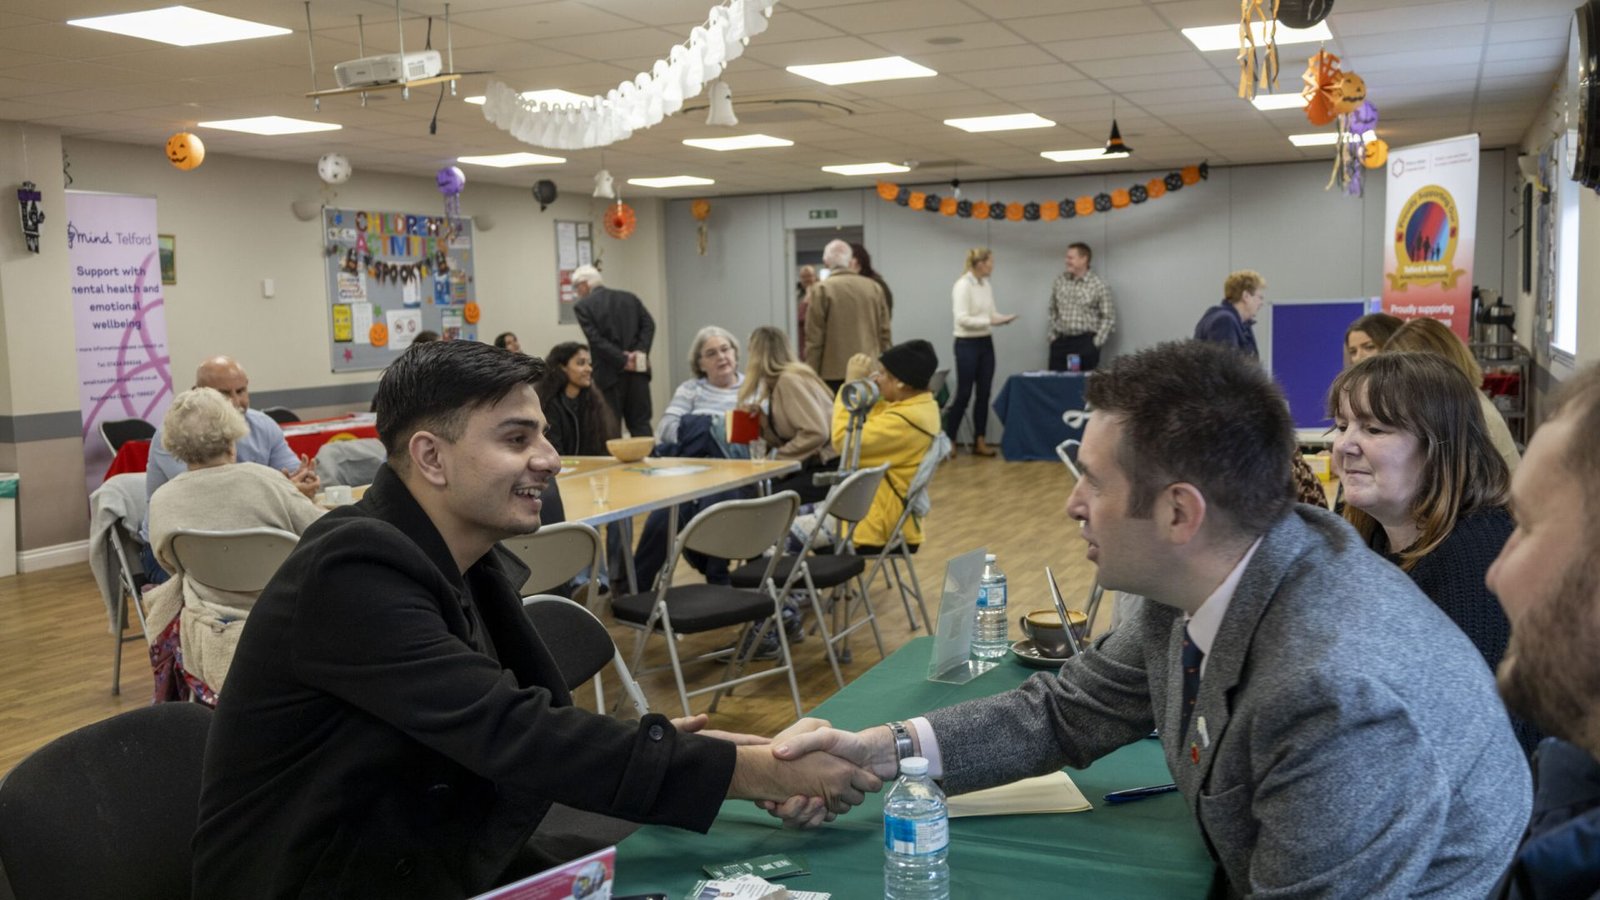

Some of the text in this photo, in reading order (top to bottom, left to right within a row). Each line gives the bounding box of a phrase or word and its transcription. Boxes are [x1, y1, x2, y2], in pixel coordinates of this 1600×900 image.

[77, 231, 152, 245] mind Telford
[76, 265, 146, 278] Support with
[106, 283, 140, 294] health
[143, 284, 159, 293] and
[89, 301, 141, 312] emotional
[1391, 304, 1455, 316] Proudly supporting
[92, 319, 142, 330] wellbeing
